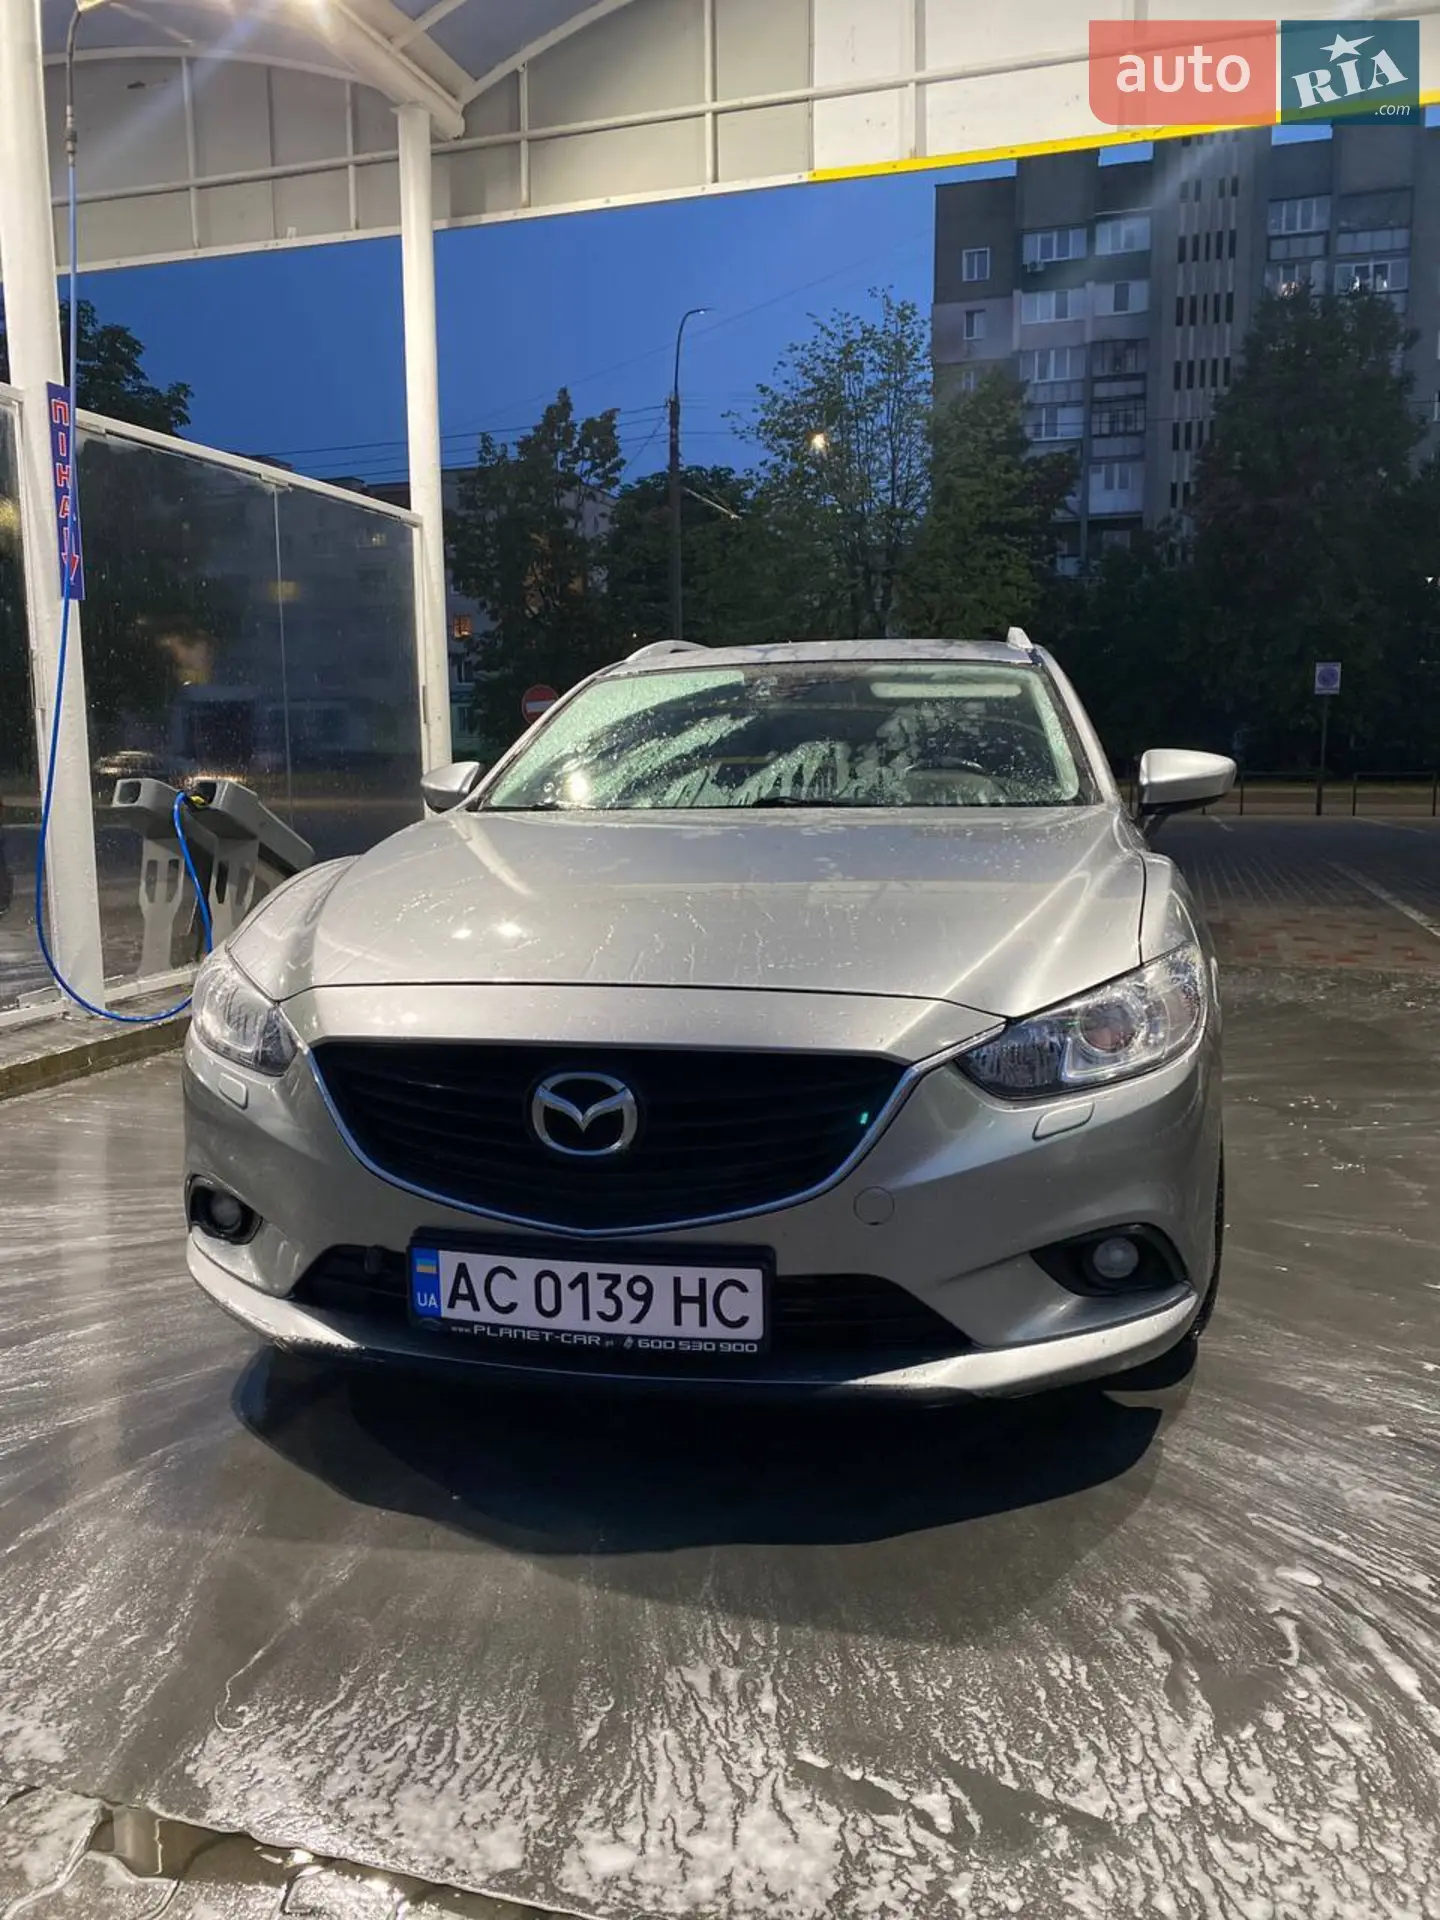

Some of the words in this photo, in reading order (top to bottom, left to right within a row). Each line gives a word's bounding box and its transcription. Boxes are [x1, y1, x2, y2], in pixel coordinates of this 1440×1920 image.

[416, 1292, 439, 1309] UA
[446, 1262, 518, 1315] AC
[534, 1269, 655, 1325] 0139
[673, 1276, 750, 1329] HC
[638, 1339, 675, 1350] 600
[678, 1340, 715, 1351] 530
[719, 1342, 757, 1353] 900
